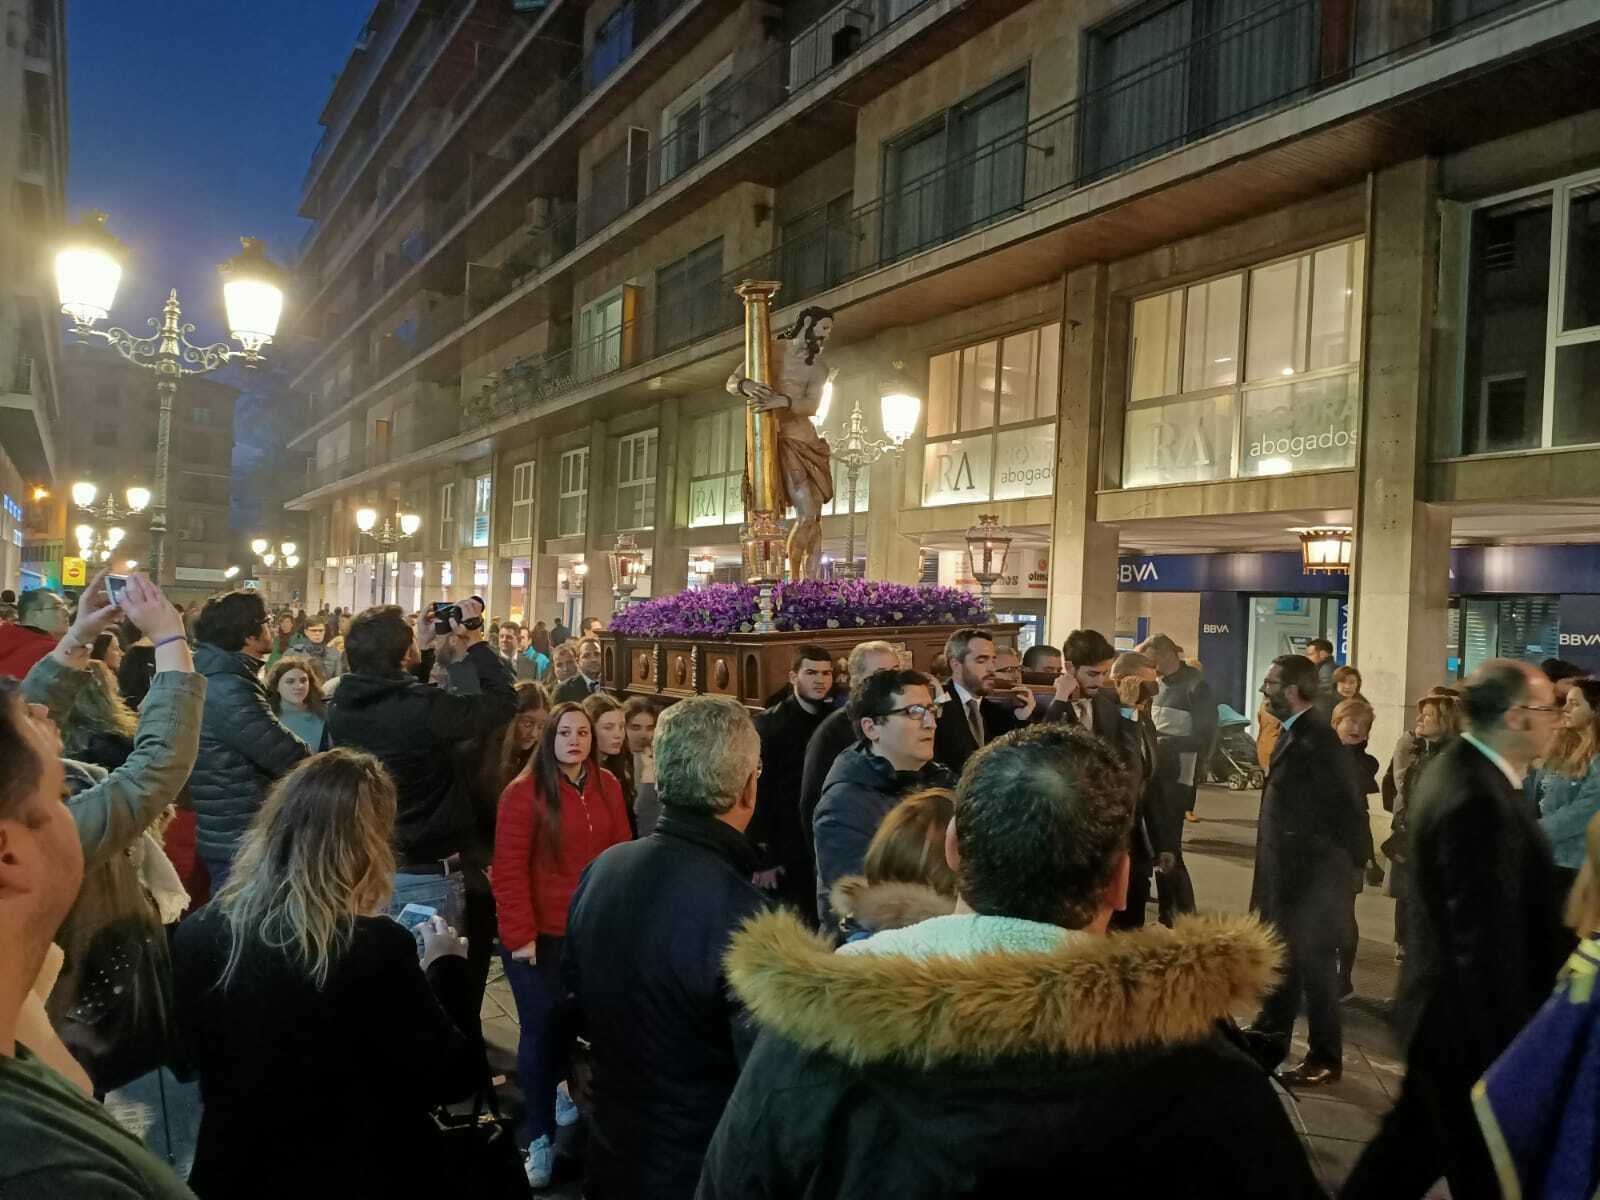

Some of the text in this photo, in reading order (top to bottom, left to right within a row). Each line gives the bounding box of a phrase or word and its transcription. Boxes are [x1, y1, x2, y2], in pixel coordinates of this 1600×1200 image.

[1250, 424, 1357, 457] abogados
[936, 451, 975, 492] RA
[1117, 561, 1159, 582] BVA
[1203, 624, 1229, 634] BBVA
